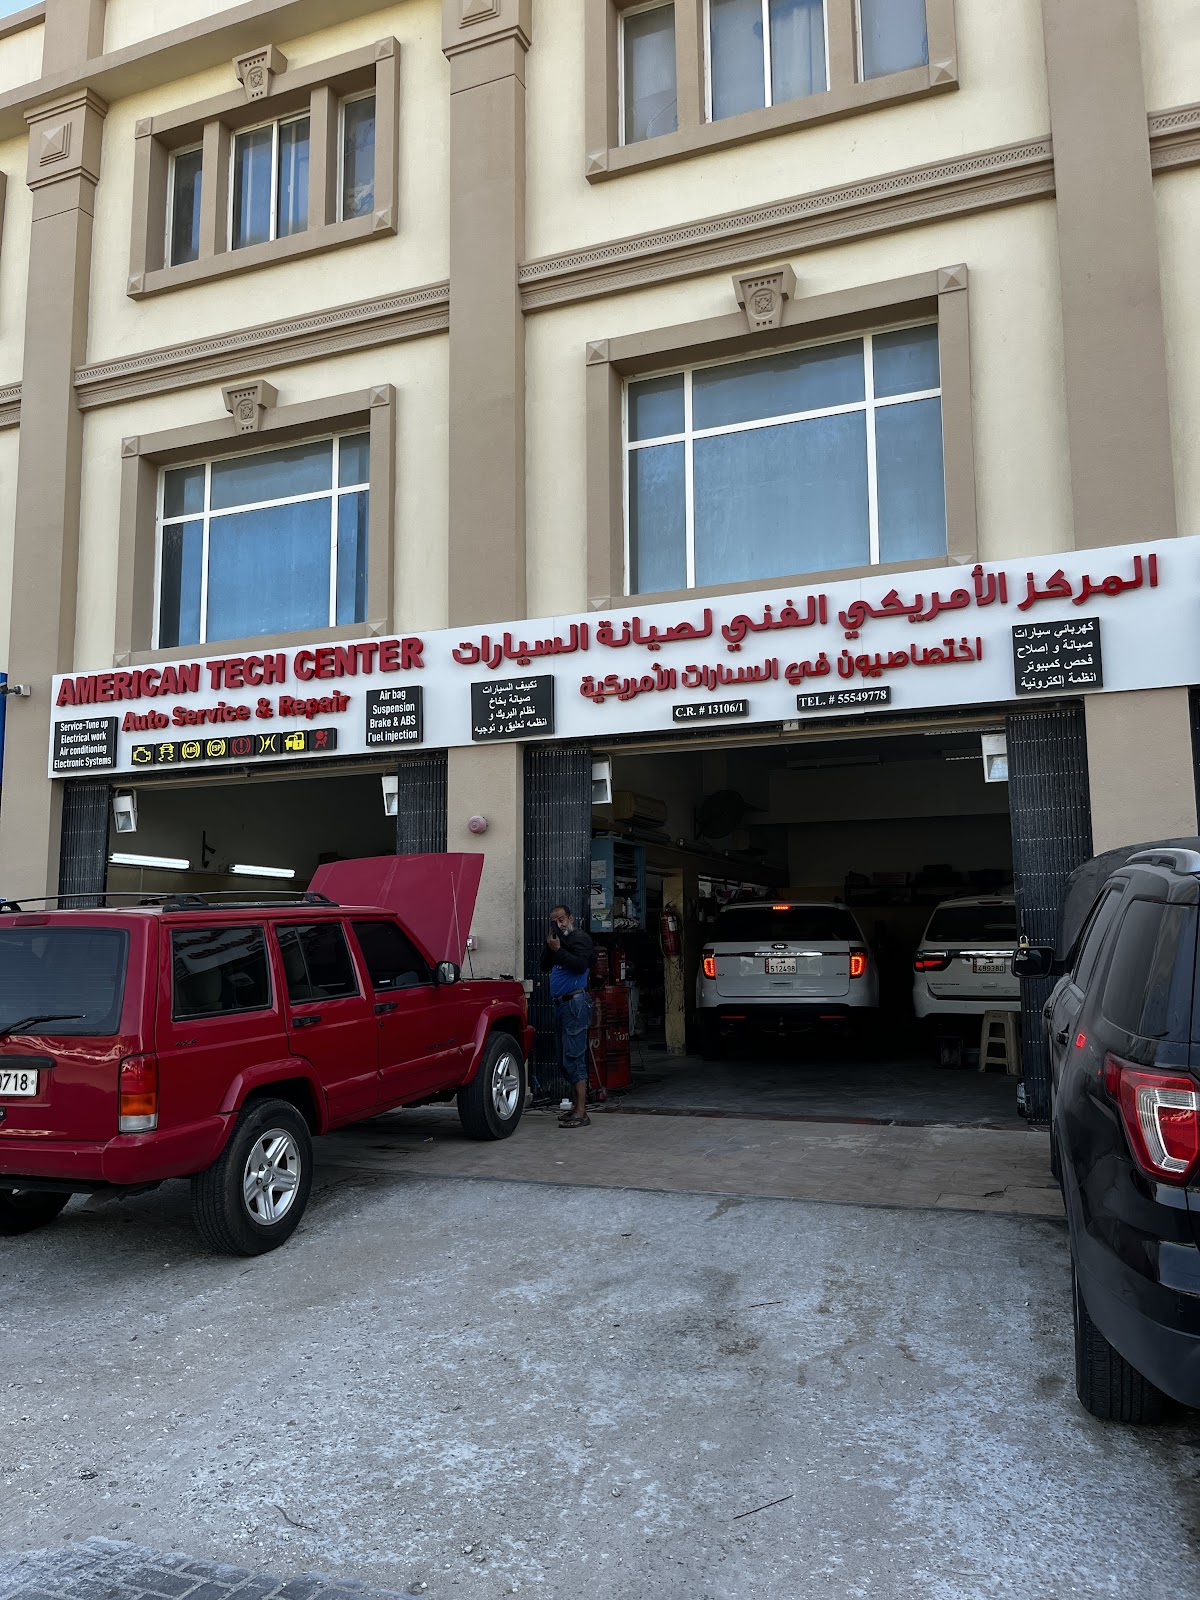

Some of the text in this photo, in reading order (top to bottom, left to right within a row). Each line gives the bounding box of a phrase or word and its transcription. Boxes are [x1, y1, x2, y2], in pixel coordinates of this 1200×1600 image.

[452, 553, 1158, 669] المركز الأمريكي الفني لصيانة السيارات
[1014, 627, 1051, 640] سيارات
[1016, 638, 1093, 659] صيانة و إصلاح
[837, 636, 982, 679] اختصاصيون
[1023, 653, 1094, 673] فحص كمبيوتر
[56, 637, 425, 707] AMERICAN TECH CENTER
[785, 652, 831, 686] في
[482, 680, 538, 695] تكييف السيارات
[580, 662, 677, 704] الأمريكية
[1020, 671, 1097, 690] انظمة إلكترونية
[379, 689, 406, 701] Air bag
[508, 693, 531, 705] صيانة
[798, 689, 887, 707] TEL. # 55549778
[121, 690, 352, 732] Auto Service & Repair
[372, 702, 415, 715] Suspension
[488, 705, 536, 721] نظام البريك و
[675, 702, 744, 718] C.R. # 13106/1
[60, 720, 109, 732] Service-Tune up
[370, 715, 416, 729] Brake & ABS
[474, 723, 496, 735] توجيه
[497, 724, 503, 733] و
[504, 720, 525, 733] تعليق
[61, 731, 107, 744] Electrical work
[385, 729, 418, 743] injection
[59, 743, 107, 756] Air conditioning
[54, 756, 112, 769] Electronic Systems
